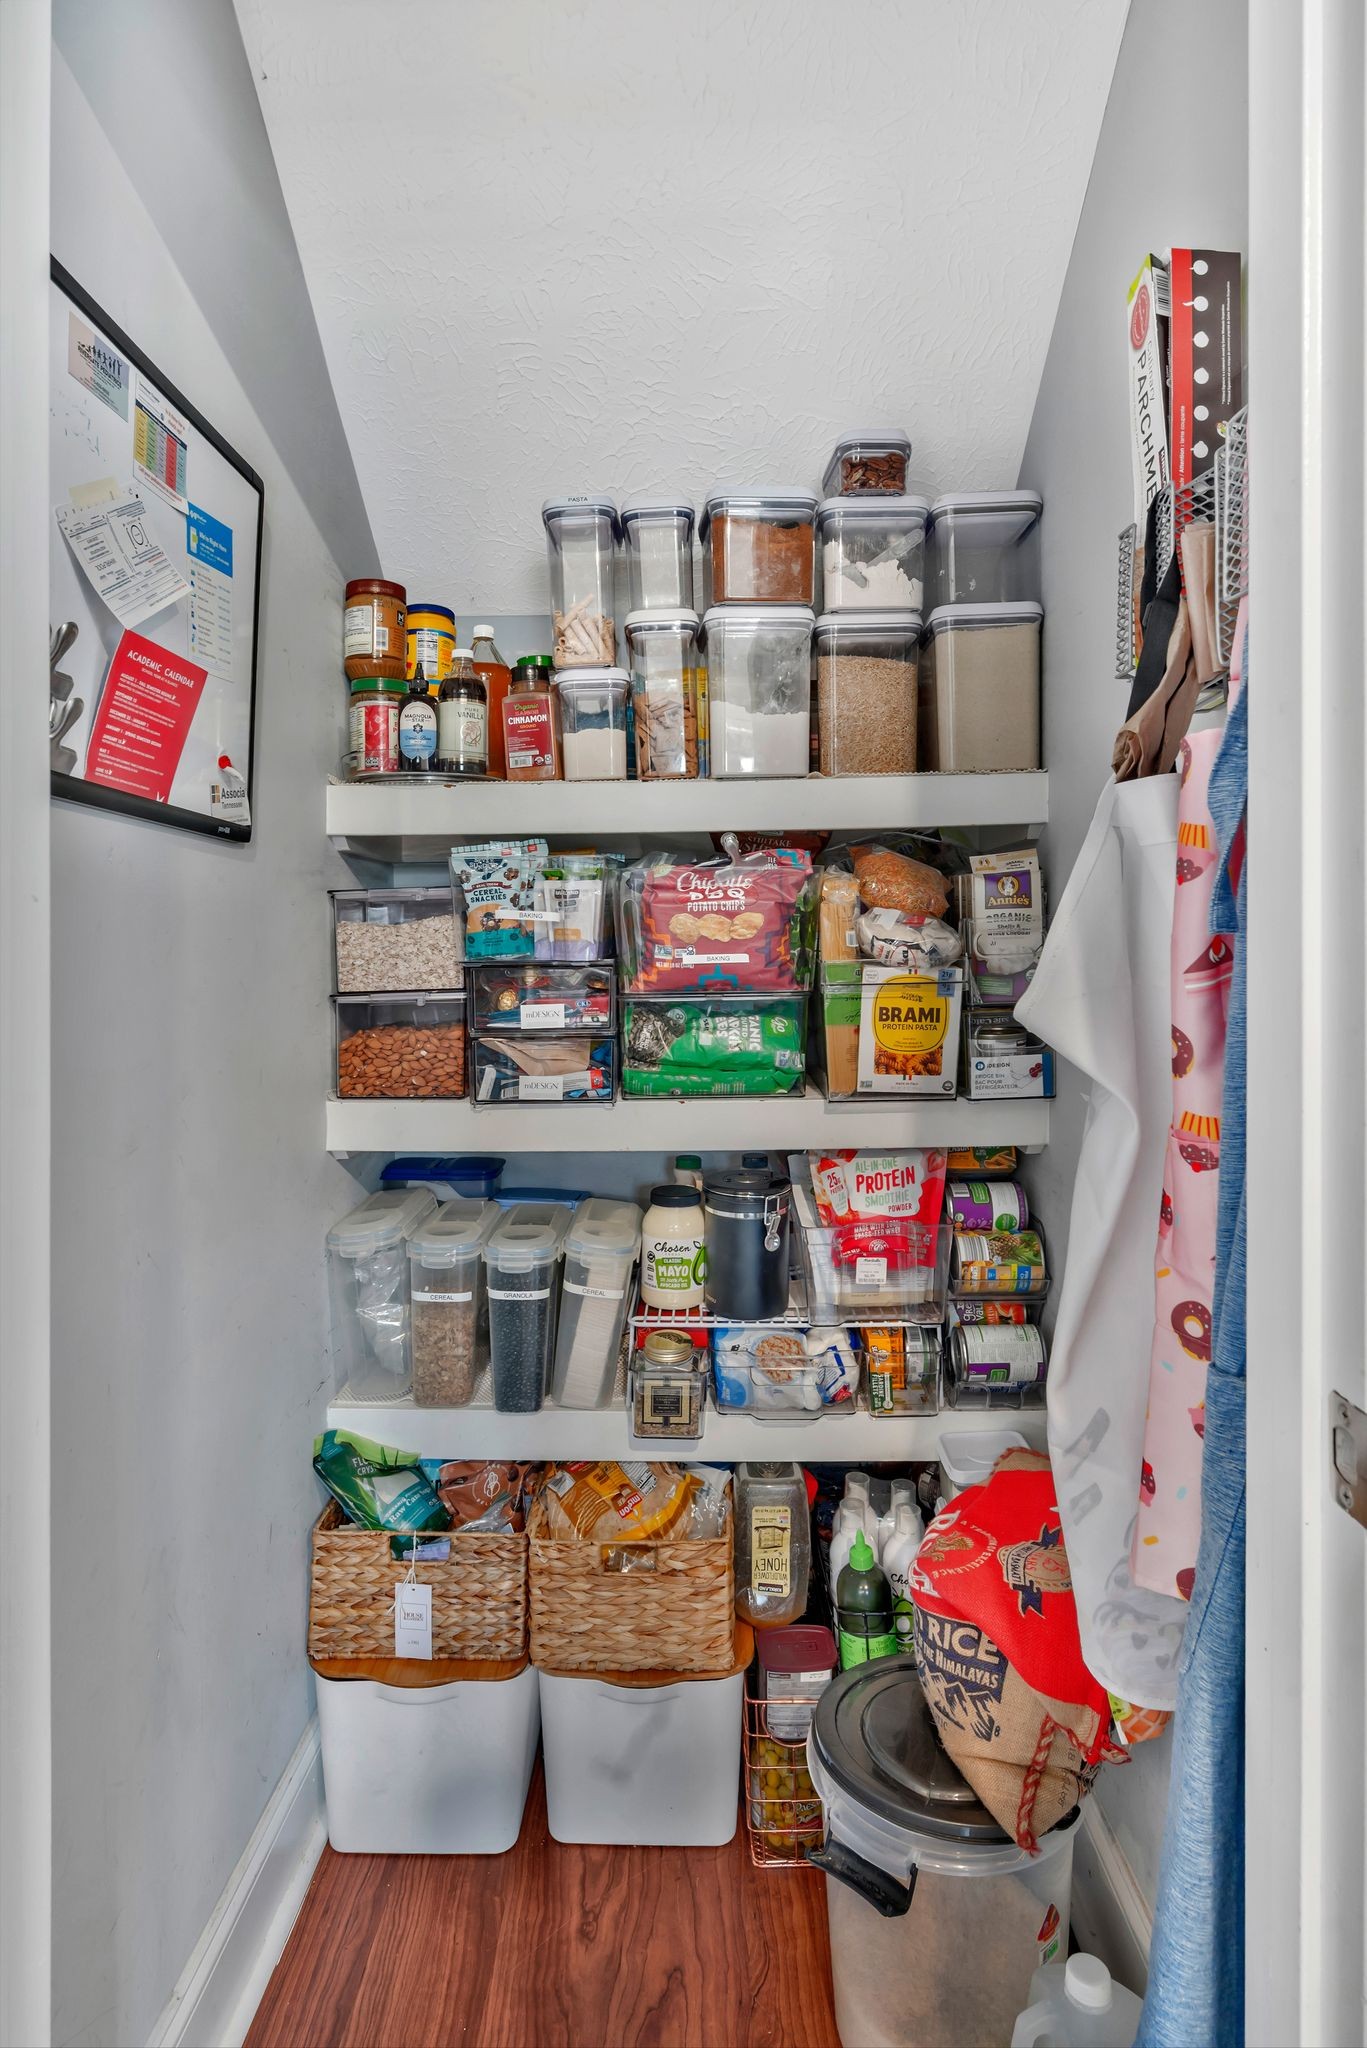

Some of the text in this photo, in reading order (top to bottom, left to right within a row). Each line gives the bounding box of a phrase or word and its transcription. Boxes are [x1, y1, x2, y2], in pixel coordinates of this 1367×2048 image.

[1137, 350, 1160, 513] PARCHME
[127, 650, 195, 689] ACADEMIC CALENDAR
[457, 711, 485, 720] VANILLA
[508, 713, 548, 725] CINNAMON
[221, 786, 246, 800] Associa
[470, 894, 507, 903] SNACKIES
[473, 888, 503, 897] CEREAL
[687, 901, 746, 912] POTATO CHIPS
[988, 894, 1030, 907] Annie's
[519, 911, 544, 919] BAKING
[525, 1010, 560, 1019] mDESIGN
[878, 1006, 941, 1023] BRAMI
[748, 1015, 761, 1051] ANIC
[882, 1023, 938, 1031] PROTEIN PASTA
[524, 1082, 559, 1090] mDESIGN
[855, 1158, 898, 1173] ALL-IN-ONE
[855, 1165, 916, 1195] PROTEIN
[830, 1185, 844, 1195] PROTEIN
[864, 1189, 910, 1208] SMOOTHIE
[888, 1202, 913, 1213] POWDER
[854, 1224, 869, 1233] MADE
[654, 1241, 691, 1252] Chosen
[657, 1265, 689, 1277] MAYO
[582, 1288, 606, 1296] CEREAL
[388, 1505, 406, 1523] Raw
[405, 1493, 421, 1507] Cane
[753, 1558, 788, 1572] HONEY
[932, 1550, 992, 1579] EXCELLENCE
[753, 1571, 788, 1581] WILDFLOWER
[890, 1573, 910, 1585] Cho
[403, 1611, 424, 1619] HOUSE
[929, 1616, 1000, 1665] RICE
[935, 1654, 999, 1689] HIMALAYAS
